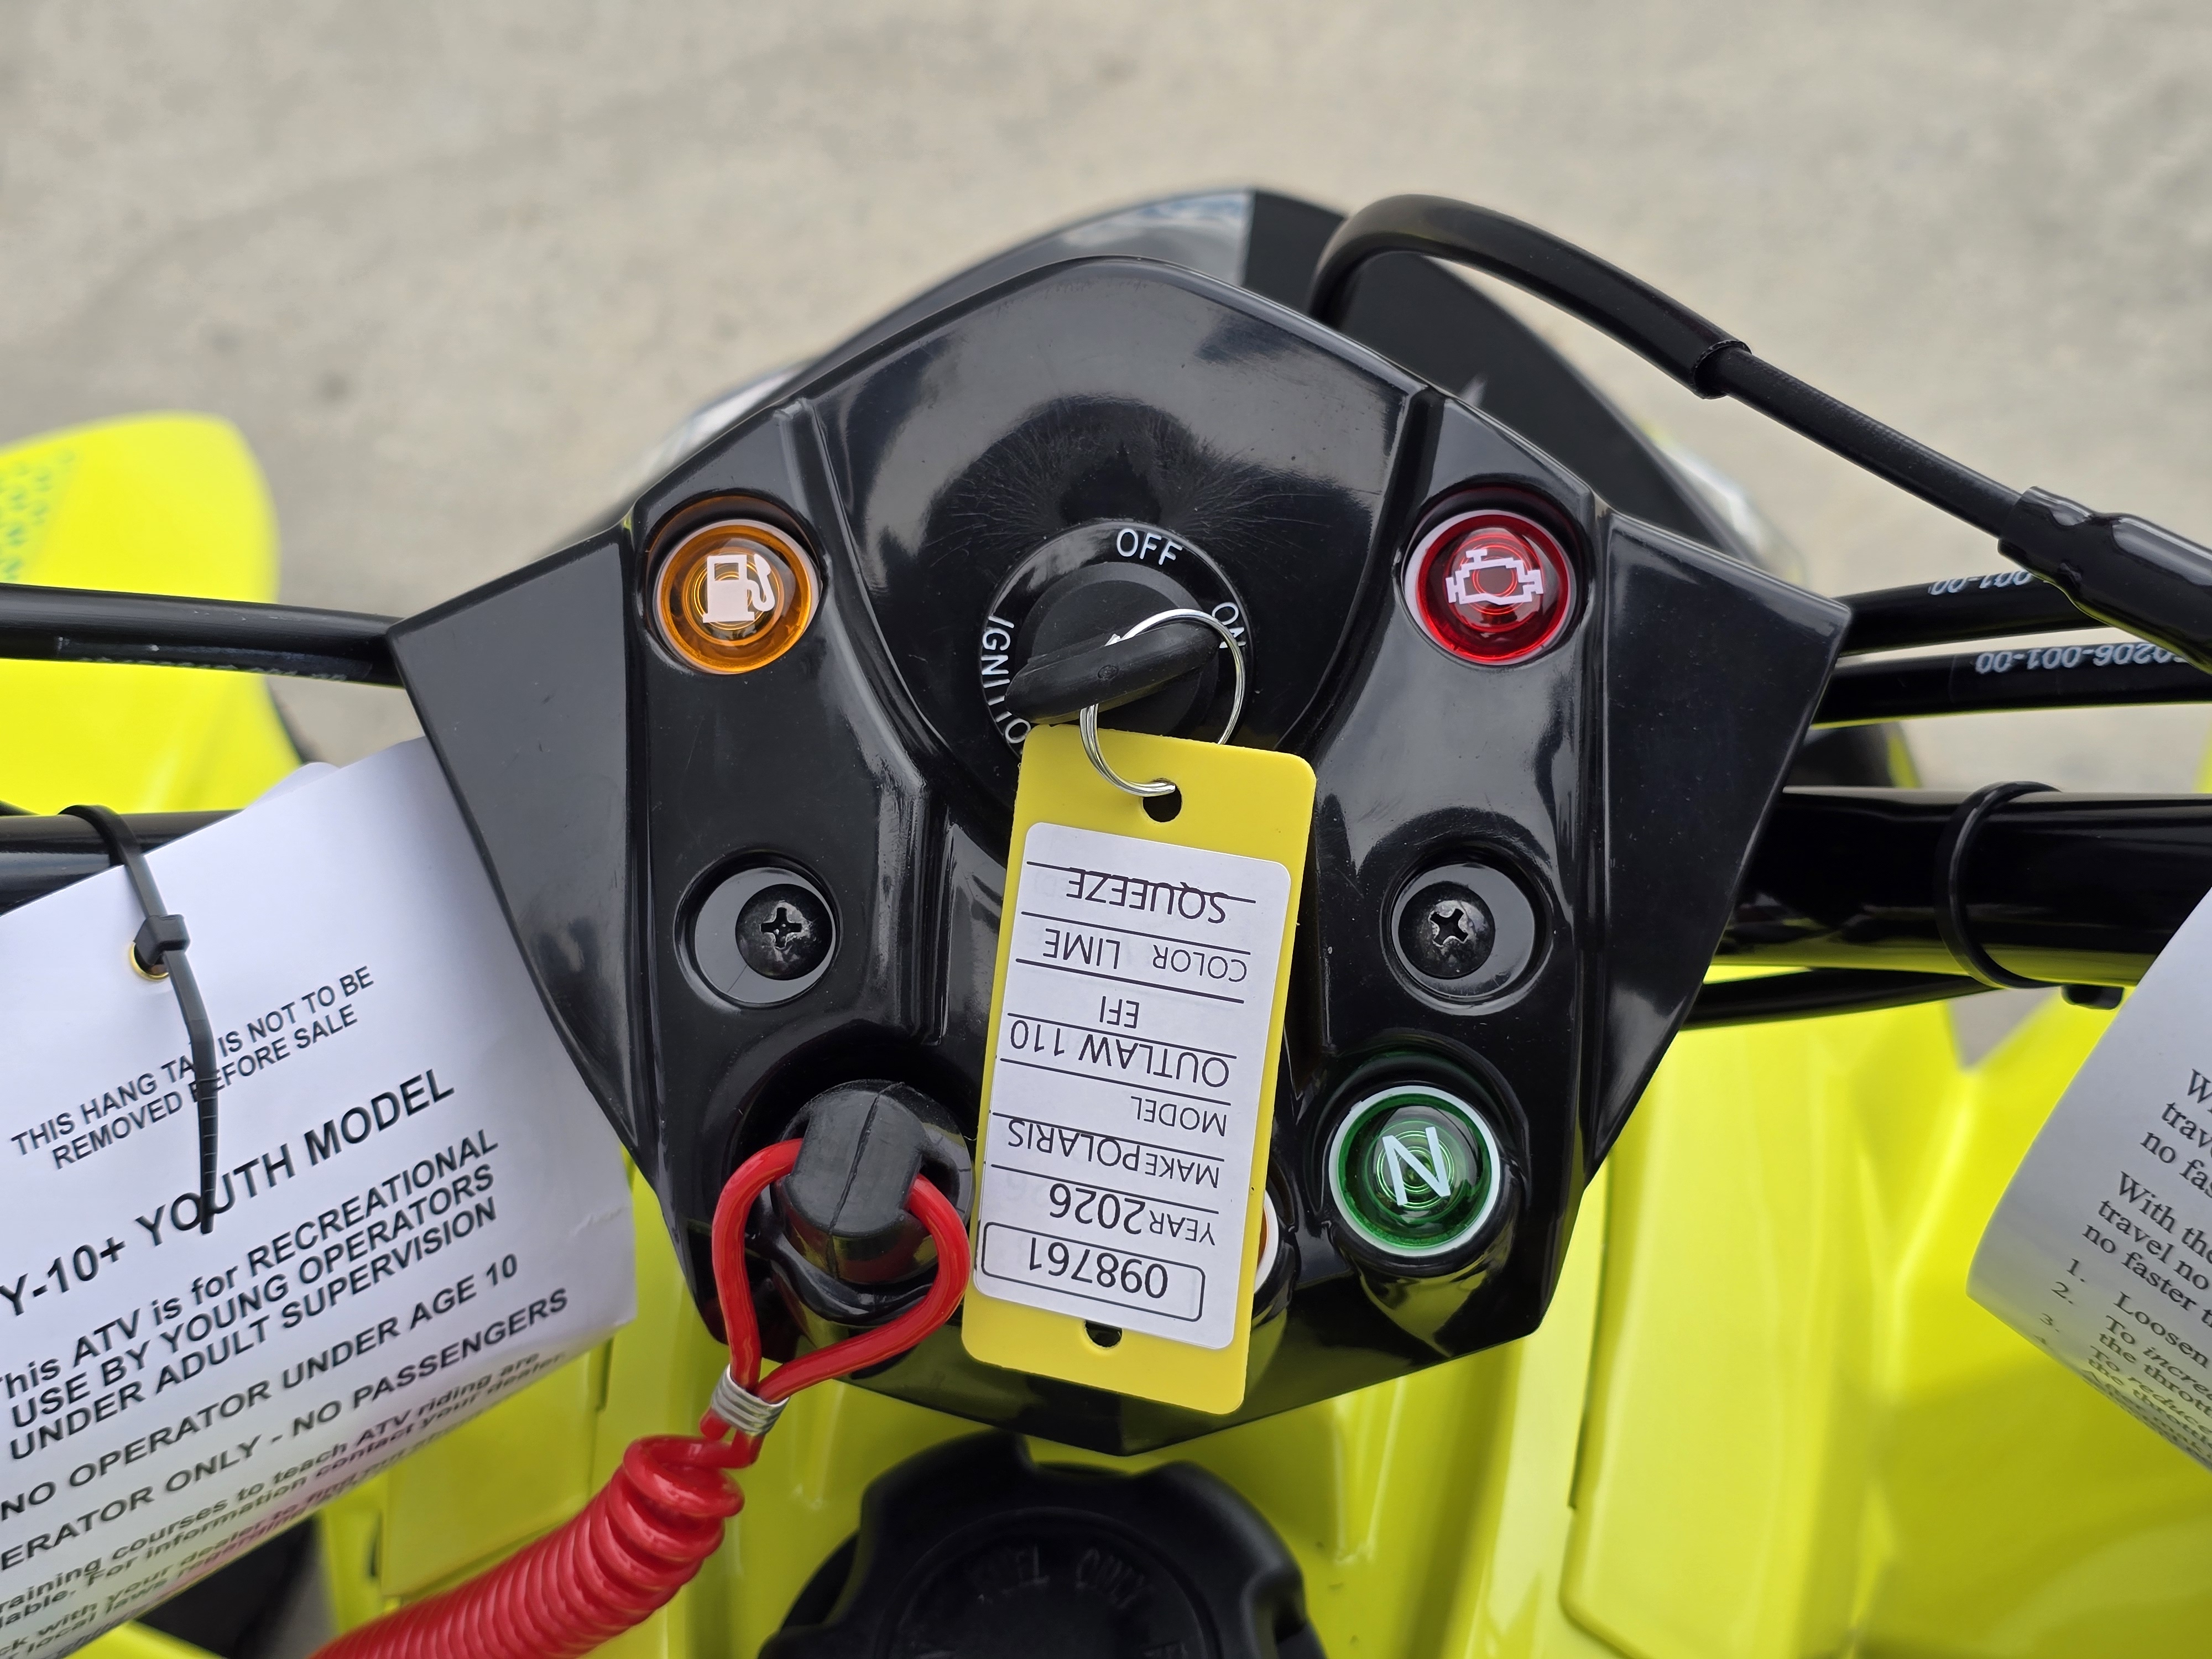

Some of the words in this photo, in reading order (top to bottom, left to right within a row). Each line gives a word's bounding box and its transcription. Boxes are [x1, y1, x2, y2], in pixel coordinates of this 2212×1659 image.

[1116, 528, 1182, 565] OFF
[1975, 641, 2189, 675] 0206-001-00
[1066, 867, 1226, 924] SQUEEZE
[1043, 928, 1120, 969] LIME
[1152, 944, 1247, 982] COLOR
[1010, 1019, 1064, 1056] 110
[1099, 996, 1139, 1029] EFI
[11, 1112, 76, 1156] THIS
[81, 1073, 158, 1123] HANG
[218, 1031, 243, 1057] IS
[247, 1001, 296, 1043] NOT
[302, 985, 335, 1015] TO
[340, 966, 374, 998] BE
[52, 1091, 183, 1169] REMOVED
[296, 1003, 358, 1048] SALE
[1079, 1034, 1229, 1087] OUTLAW
[2187, 1068, 2212, 1114] W
[1130, 1096, 1227, 1136] MODEL
[2161, 1102, 2212, 1157] trav
[1383, 1126, 1451, 1206] N
[2140, 1131, 2176, 1164] no
[0, 1237, 126, 1316] Y-10+
[136, 1142, 296, 1247] YOUTH
[303, 1068, 455, 1166] MODEL
[2119, 1171, 2176, 1234] With
[0, 1358, 61, 1399] his
[74, 1308, 140, 1368] ATV
[152, 1297, 182, 1326] is
[192, 1266, 238, 1305] for
[247, 1129, 498, 1276] RECREATIONAL
[1029, 1237, 1168, 1298] 098761
[2082, 1224, 2116, 1254] no
[2121, 1252, 2197, 1311] faster
[2098, 1201, 2174, 1264] travel
[2173, 1260, 2209, 1290] no
[12, 1372, 91, 1428] USE
[101, 1339, 150, 1386] BY
[161, 1274, 289, 1353] YOUNG
[299, 1163, 494, 1284] OPERATORS
[2051, 1282, 2073, 1304] 2.
[2105, 1315, 2136, 1344] To
[2066, 1258, 2085, 1282] 1.
[2114, 1291, 2209, 1369] Loosen
[10, 1381, 146, 1459] UNDER
[156, 1314, 270, 1395] ADULT
[283, 1196, 497, 1329] SUPERVISION
[2039, 1313, 2059, 1332] 3.
[2090, 1345, 2120, 1371] To
[2099, 1333, 2136, 1363] the
[1, 1481, 56, 1521] NO
[69, 1380, 273, 1488] OPERATOR
[283, 1316, 400, 1389] UNDER
[410, 1274, 477, 1330] AGE
[487, 1254, 518, 1286] 10
[166, 1434, 262, 1491] ONLY
[272, 1434, 284, 1443] -
[293, 1399, 342, 1437] NO
[353, 1287, 568, 1409] PASSENGERS
[2088, 1358, 2124, 1385] the
[112, 1499, 228, 1560] courses
[237, 1483, 265, 1501] to
[274, 1443, 348, 1484] teach
[356, 1408, 412, 1447] ATV
[418, 1374, 492, 1416] riding
[500, 1353, 540, 1378] are
[87, 1556, 138, 1587] For
[146, 1476, 307, 1559] information
[315, 1423, 414, 1477] contact
[420, 1392, 482, 1429] your
[38, 1603, 98, 1635] with
[107, 1564, 174, 1604] your
[180, 1519, 267, 1566] dealer
[28, 1611, 96, 1652] local
